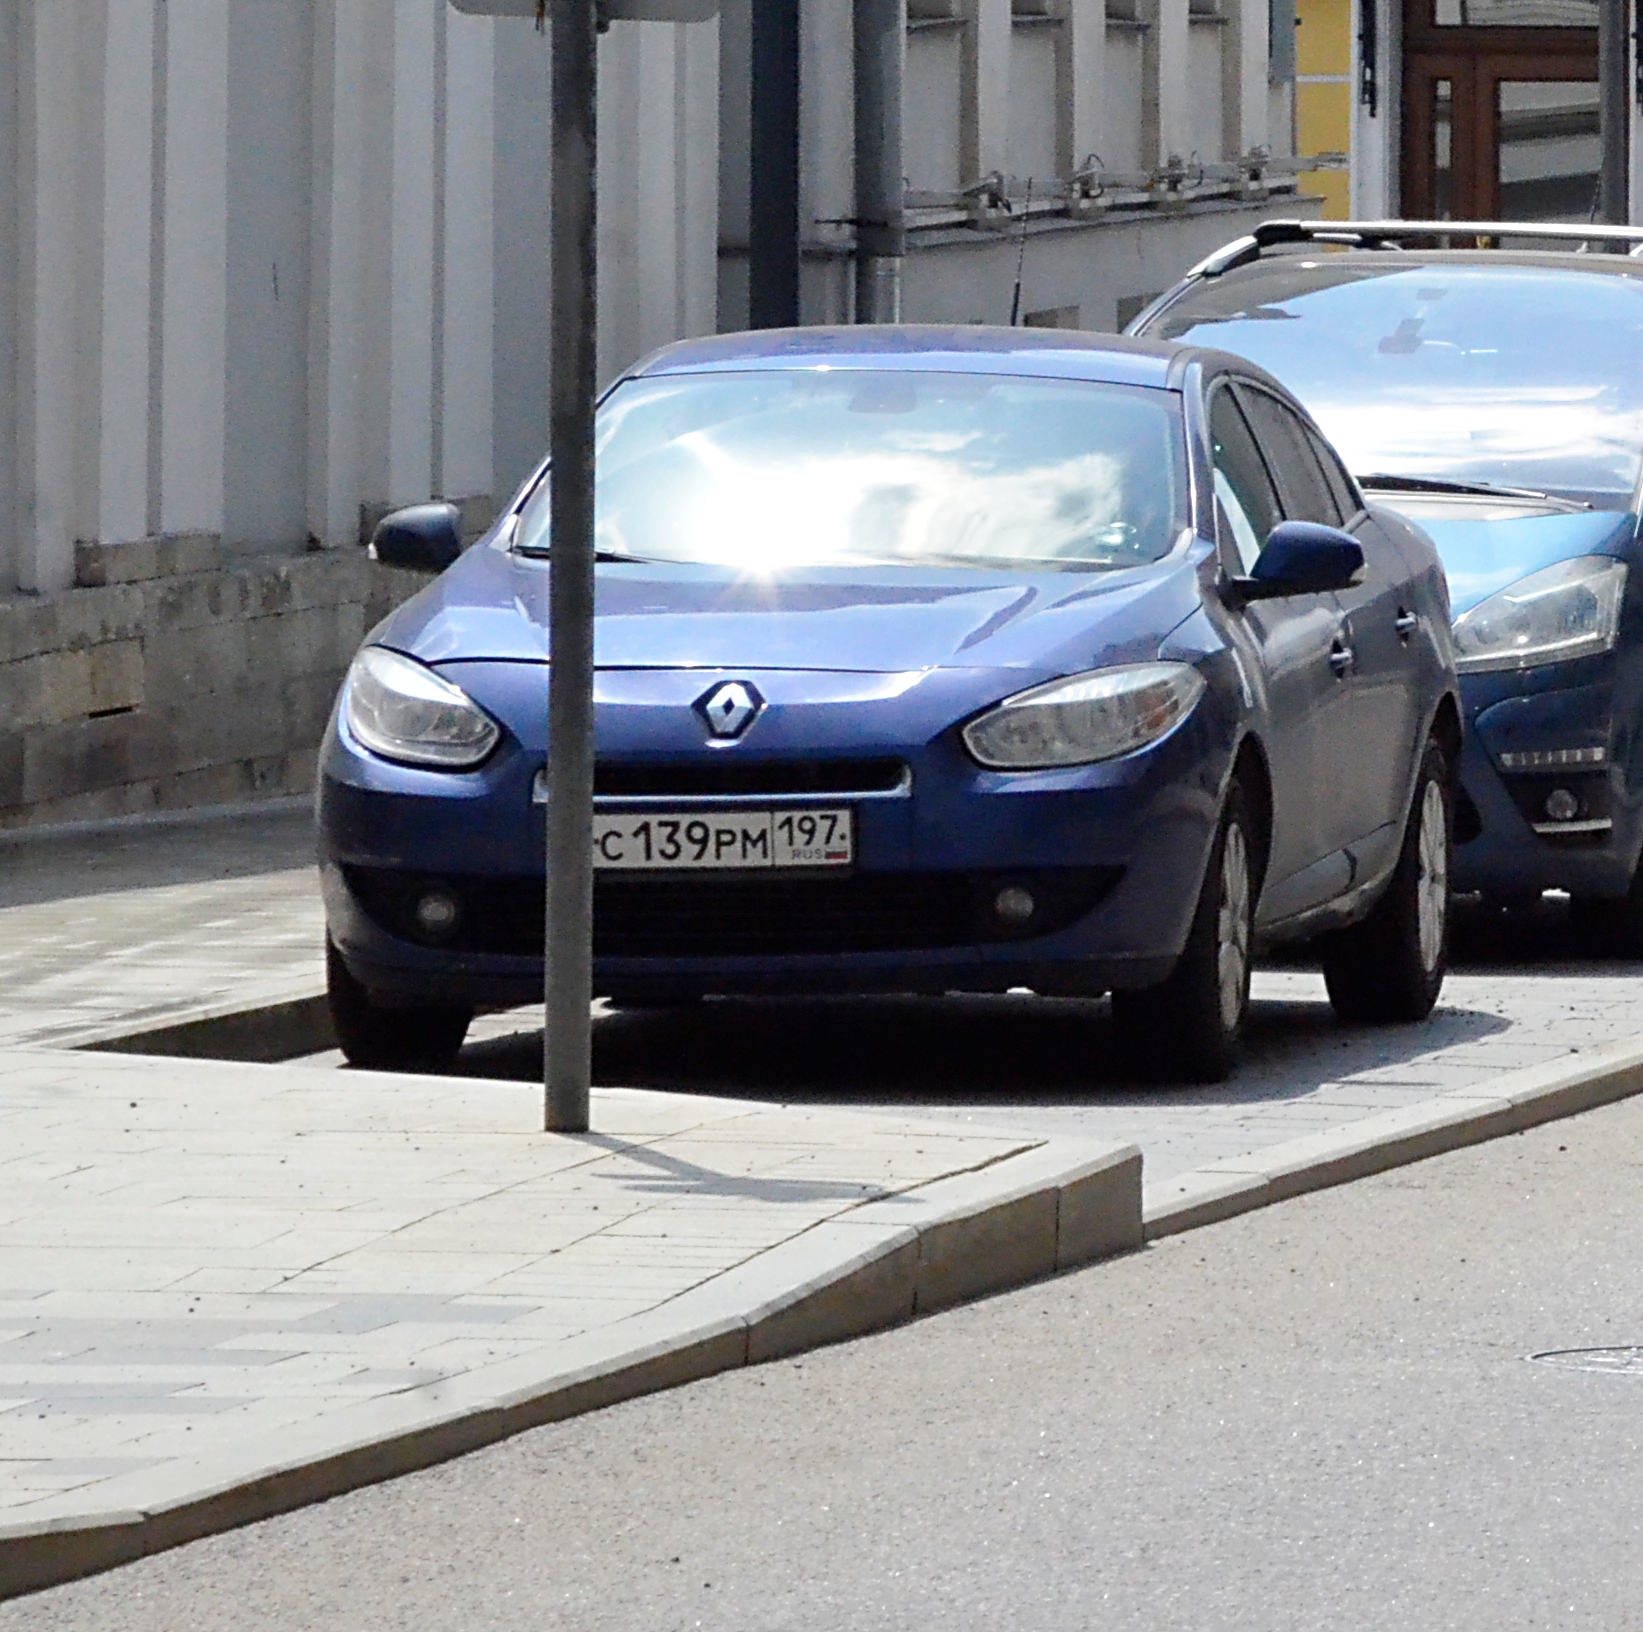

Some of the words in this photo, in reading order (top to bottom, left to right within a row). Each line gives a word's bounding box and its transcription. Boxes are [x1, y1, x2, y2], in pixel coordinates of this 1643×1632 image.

[600, 820, 768, 862] С139РМ
[778, 814, 838, 847] 197
[791, 848, 825, 860] RUS
